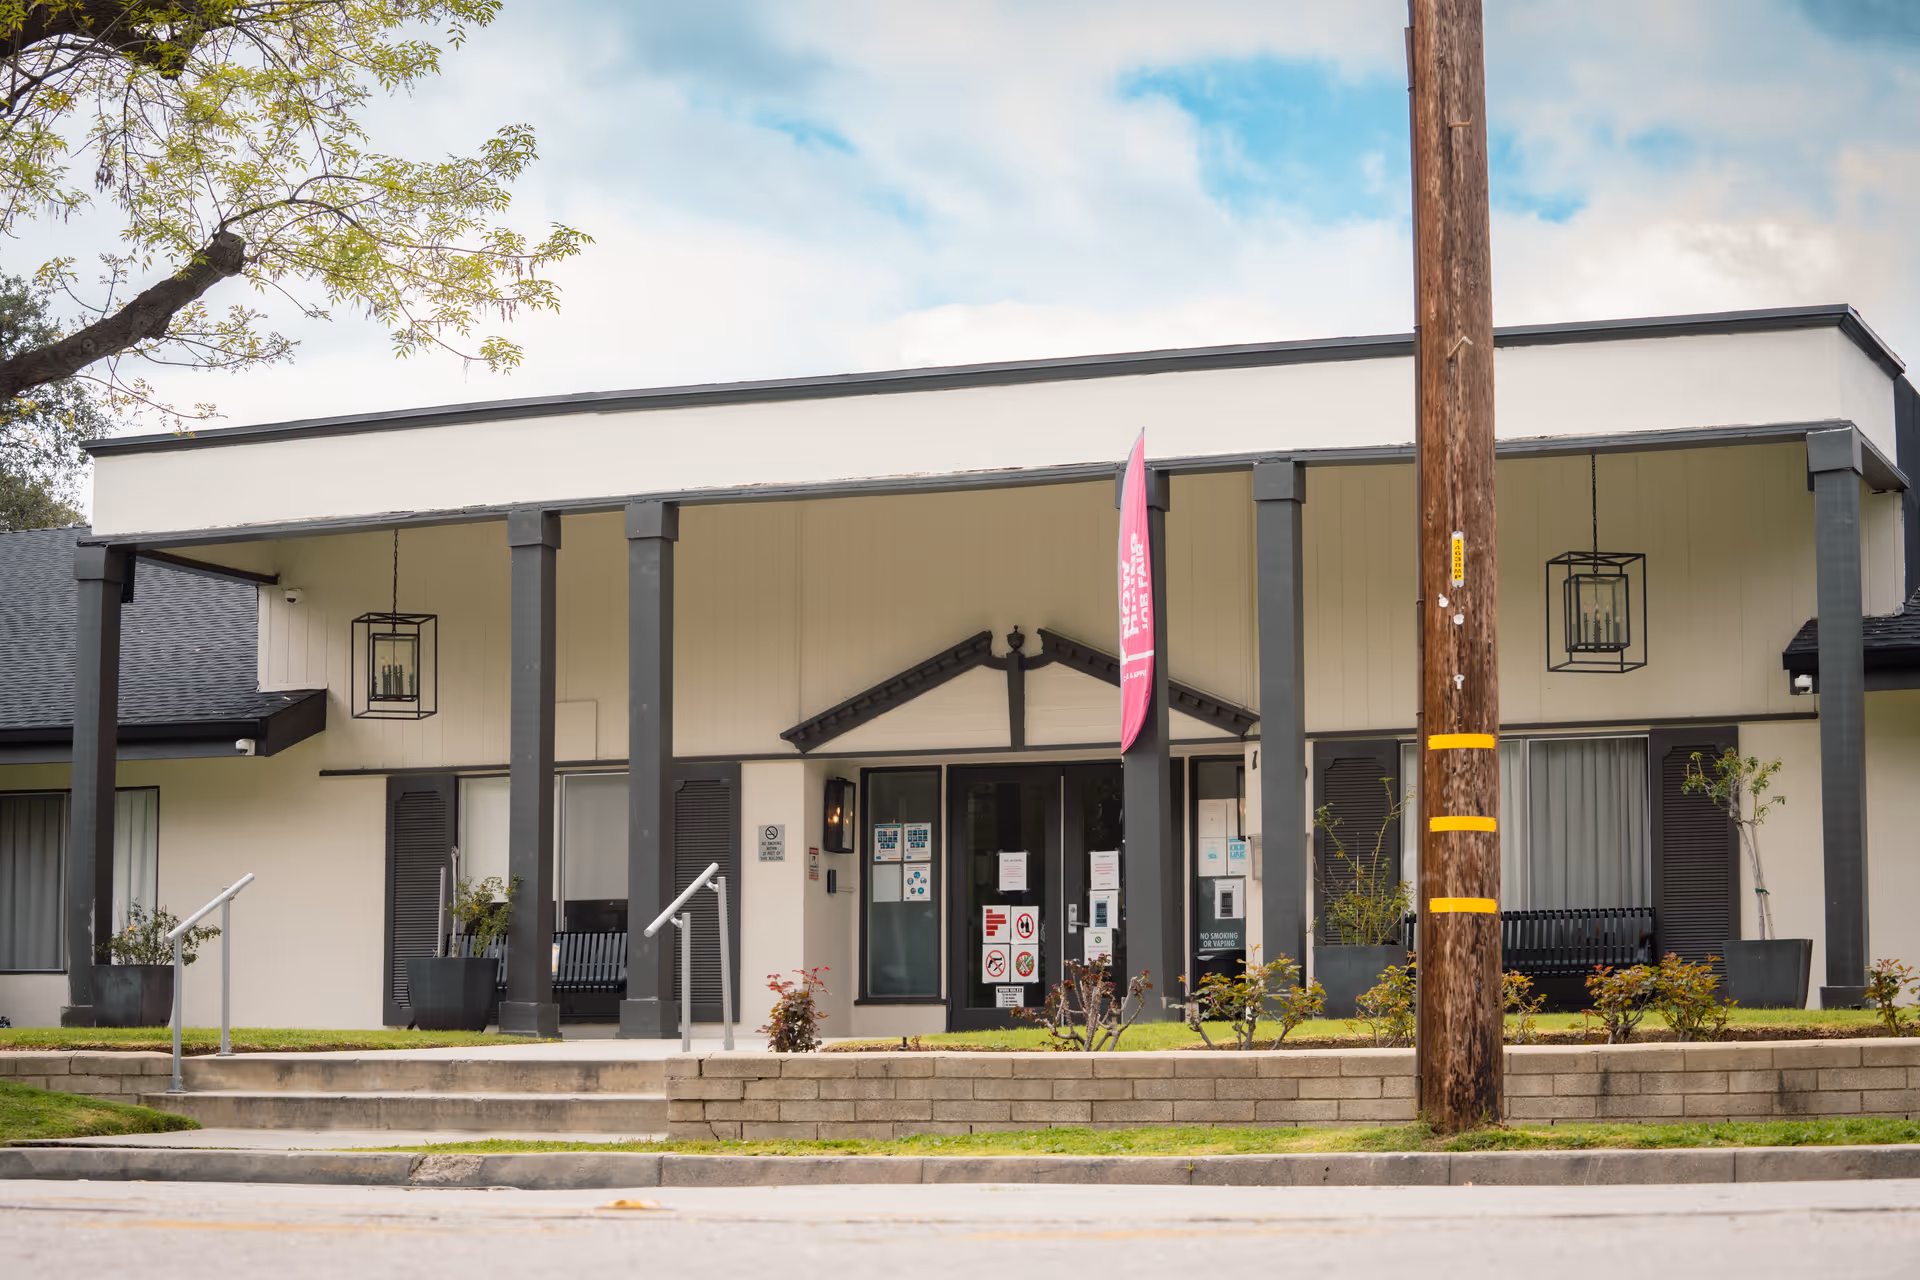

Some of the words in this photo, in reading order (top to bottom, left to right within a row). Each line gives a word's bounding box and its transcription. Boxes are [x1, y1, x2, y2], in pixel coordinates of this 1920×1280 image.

[1136, 543, 1149, 589] FAIR
[1122, 560, 1130, 640] NOW
[1140, 593, 1148, 632] JOB
[1200, 932, 1210, 940] NO
[1210, 932, 1239, 940] SMOKING
